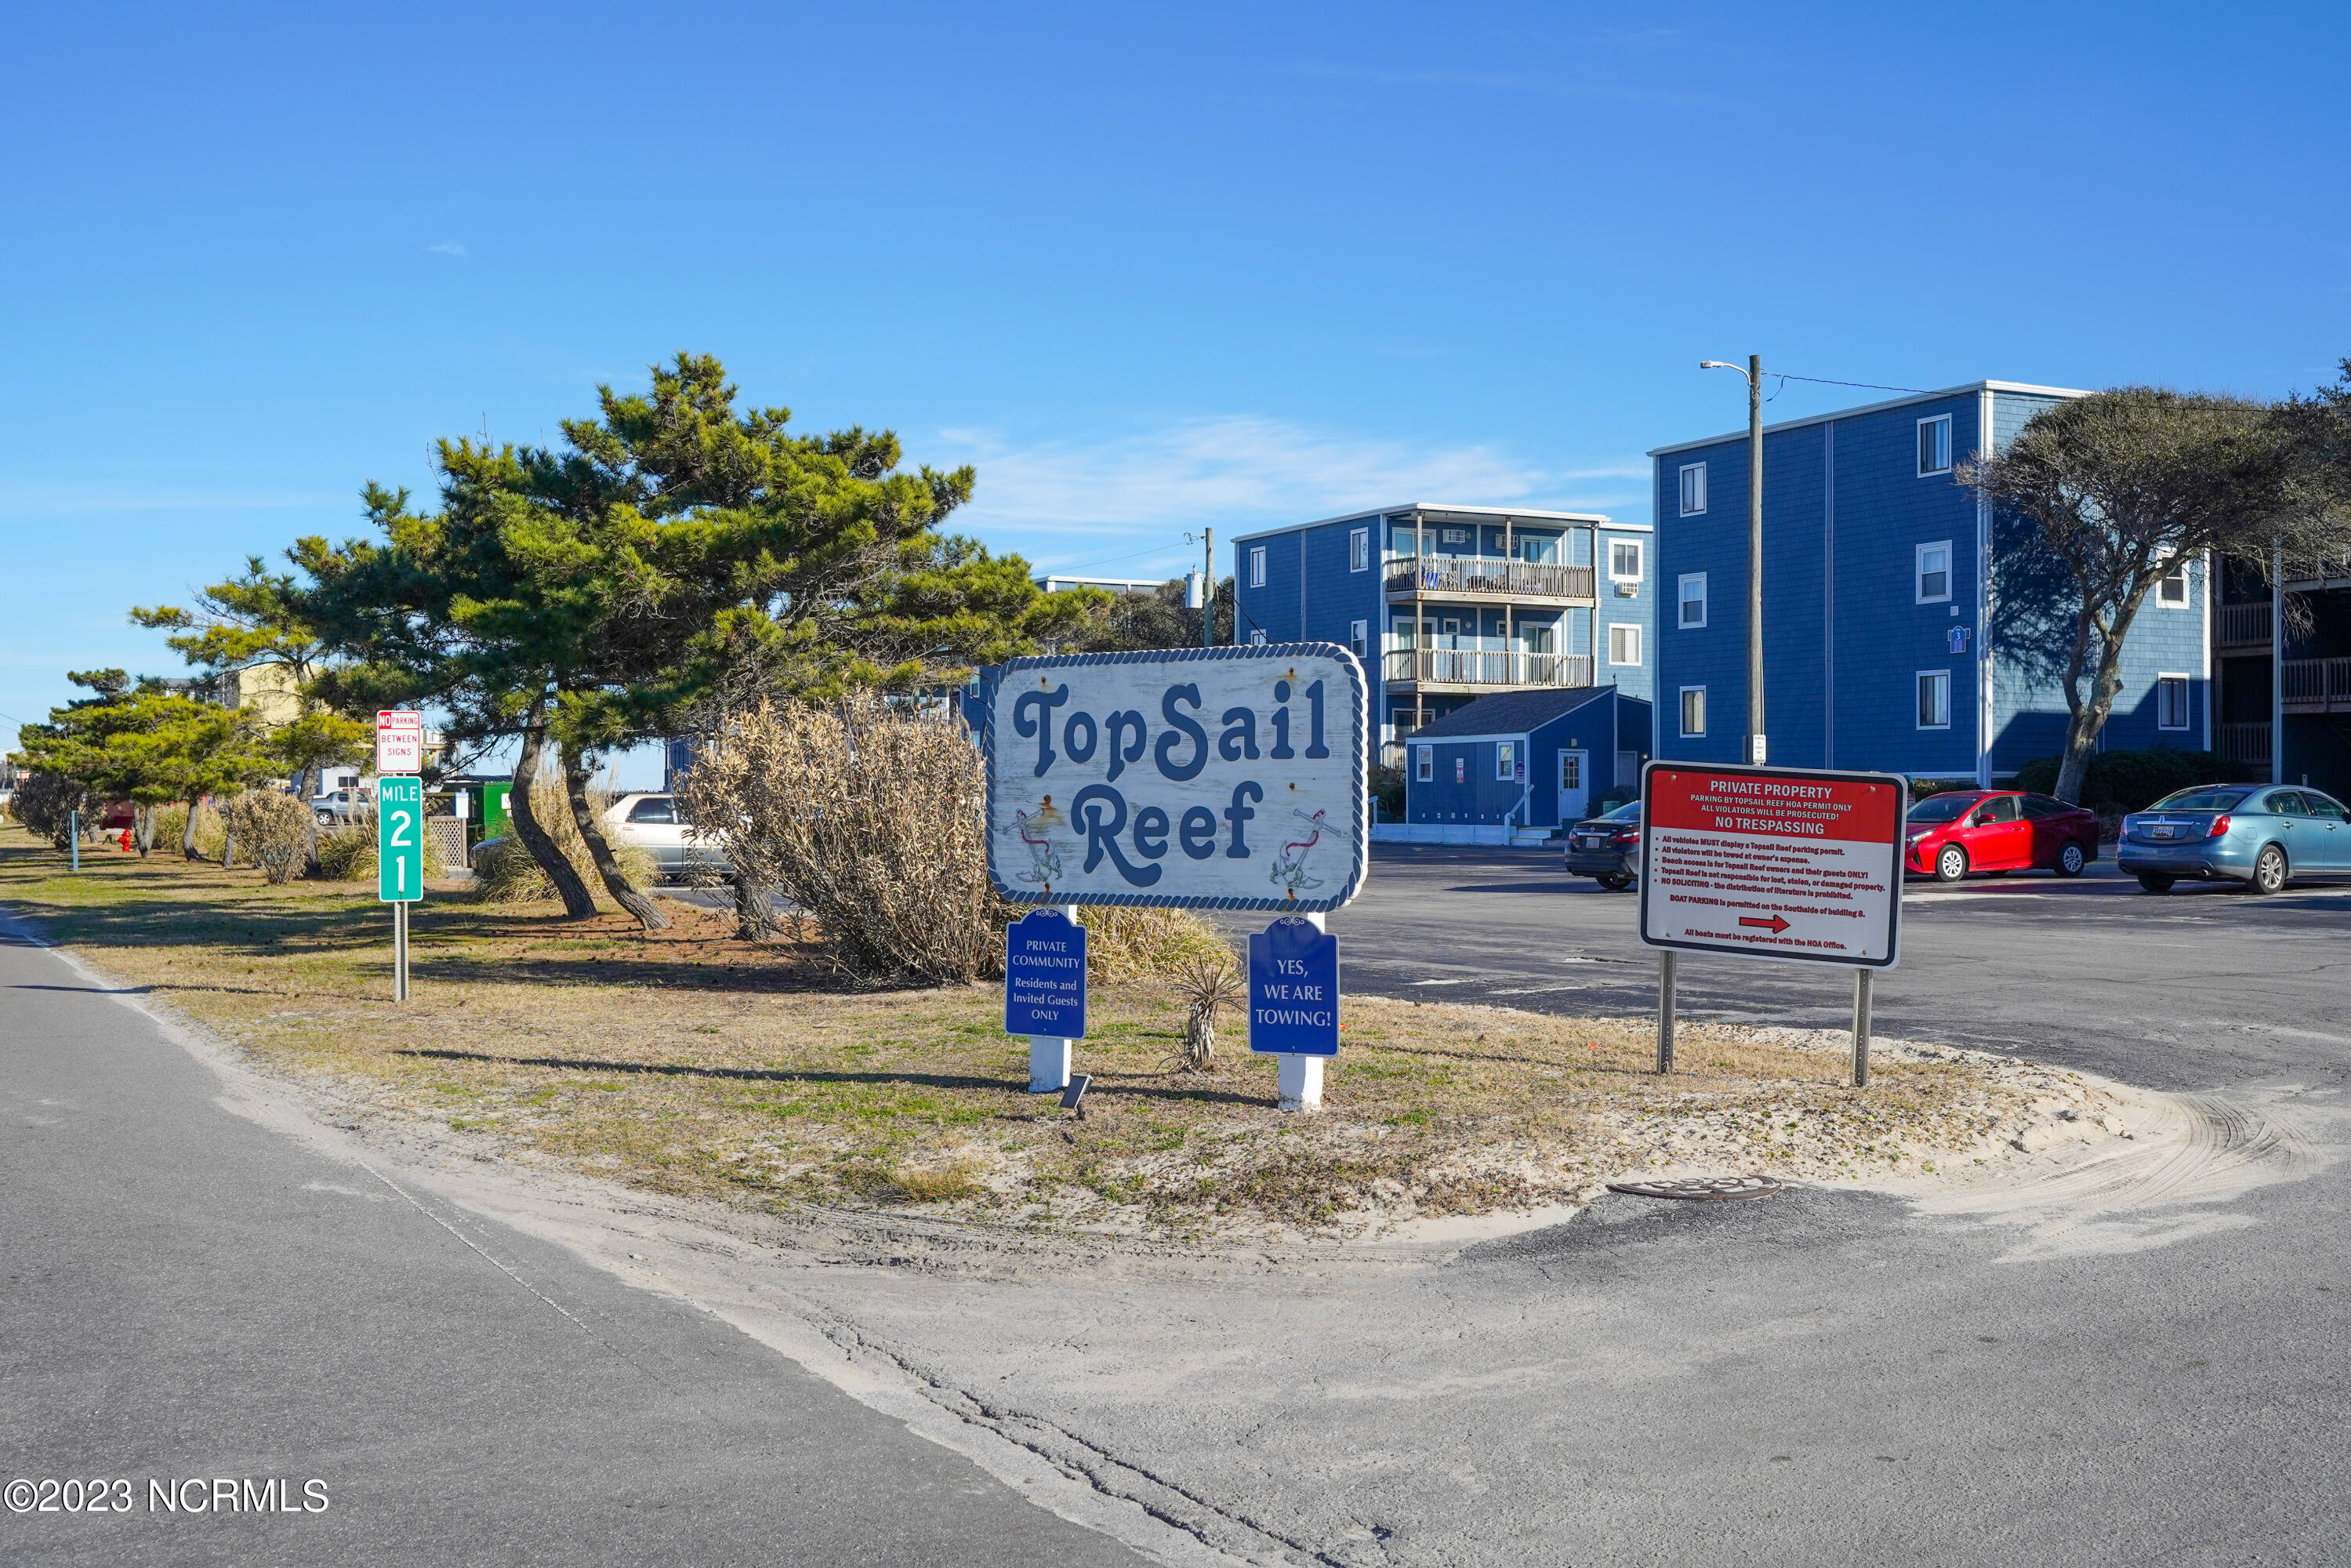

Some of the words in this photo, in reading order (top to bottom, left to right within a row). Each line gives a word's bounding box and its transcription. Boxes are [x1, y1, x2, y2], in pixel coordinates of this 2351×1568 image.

[379, 715, 390, 726] NO
[1013, 678, 1330, 782] TopSail
[383, 786, 418, 801] MILE
[1711, 780, 1761, 794] PRIVATE
[1765, 784, 1832, 799] PROPERTY
[1690, 794, 1722, 803] PARKING
[1734, 797, 1765, 806] TOPSAIL
[1715, 806, 1754, 815] VIOLATORS
[1787, 811, 1839, 820] PROSECUTED!
[390, 811, 411, 847] 2
[1715, 816, 1732, 828] NO
[1736, 818, 1824, 834] TRESPASSING
[1071, 780, 1264, 887] Reef
[1721, 840, 1744, 849] display
[1751, 842, 1774, 851] Topsail
[1793, 846, 1819, 855] parking
[397, 856, 405, 891] 1
[1725, 862, 1748, 871] Topsail
[1672, 879, 1709, 887] SOLICITING
[1726, 884, 1765, 892] distribution
[1721, 873, 1759, 882] responsible
[1772, 876, 1786, 884] lost,
[1787, 877, 1811, 886] stolen,
[1821, 880, 1852, 889] damaged
[1853, 883, 1885, 892] property.
[1689, 897, 1718, 906] PARKING
[1727, 900, 1760, 909] permitted
[1783, 905, 1818, 913] Southside
[1026, 941, 1066, 952] PRIVATE
[1743, 935, 1777, 944] registered
[1013, 955, 1080, 968] COMMUNITY
[1277, 960, 1308, 978] YES,
[1015, 978, 1057, 989] Residents
[1060, 980, 1077, 990] and
[1014, 993, 1044, 1004] Invited
[1048, 995, 1078, 1006] Guests
[1264, 985, 1289, 999] WE
[1293, 985, 1322, 1000] ARE
[1032, 1010, 1059, 1021] ONLY
[1256, 1009, 1331, 1027] TOWING!
